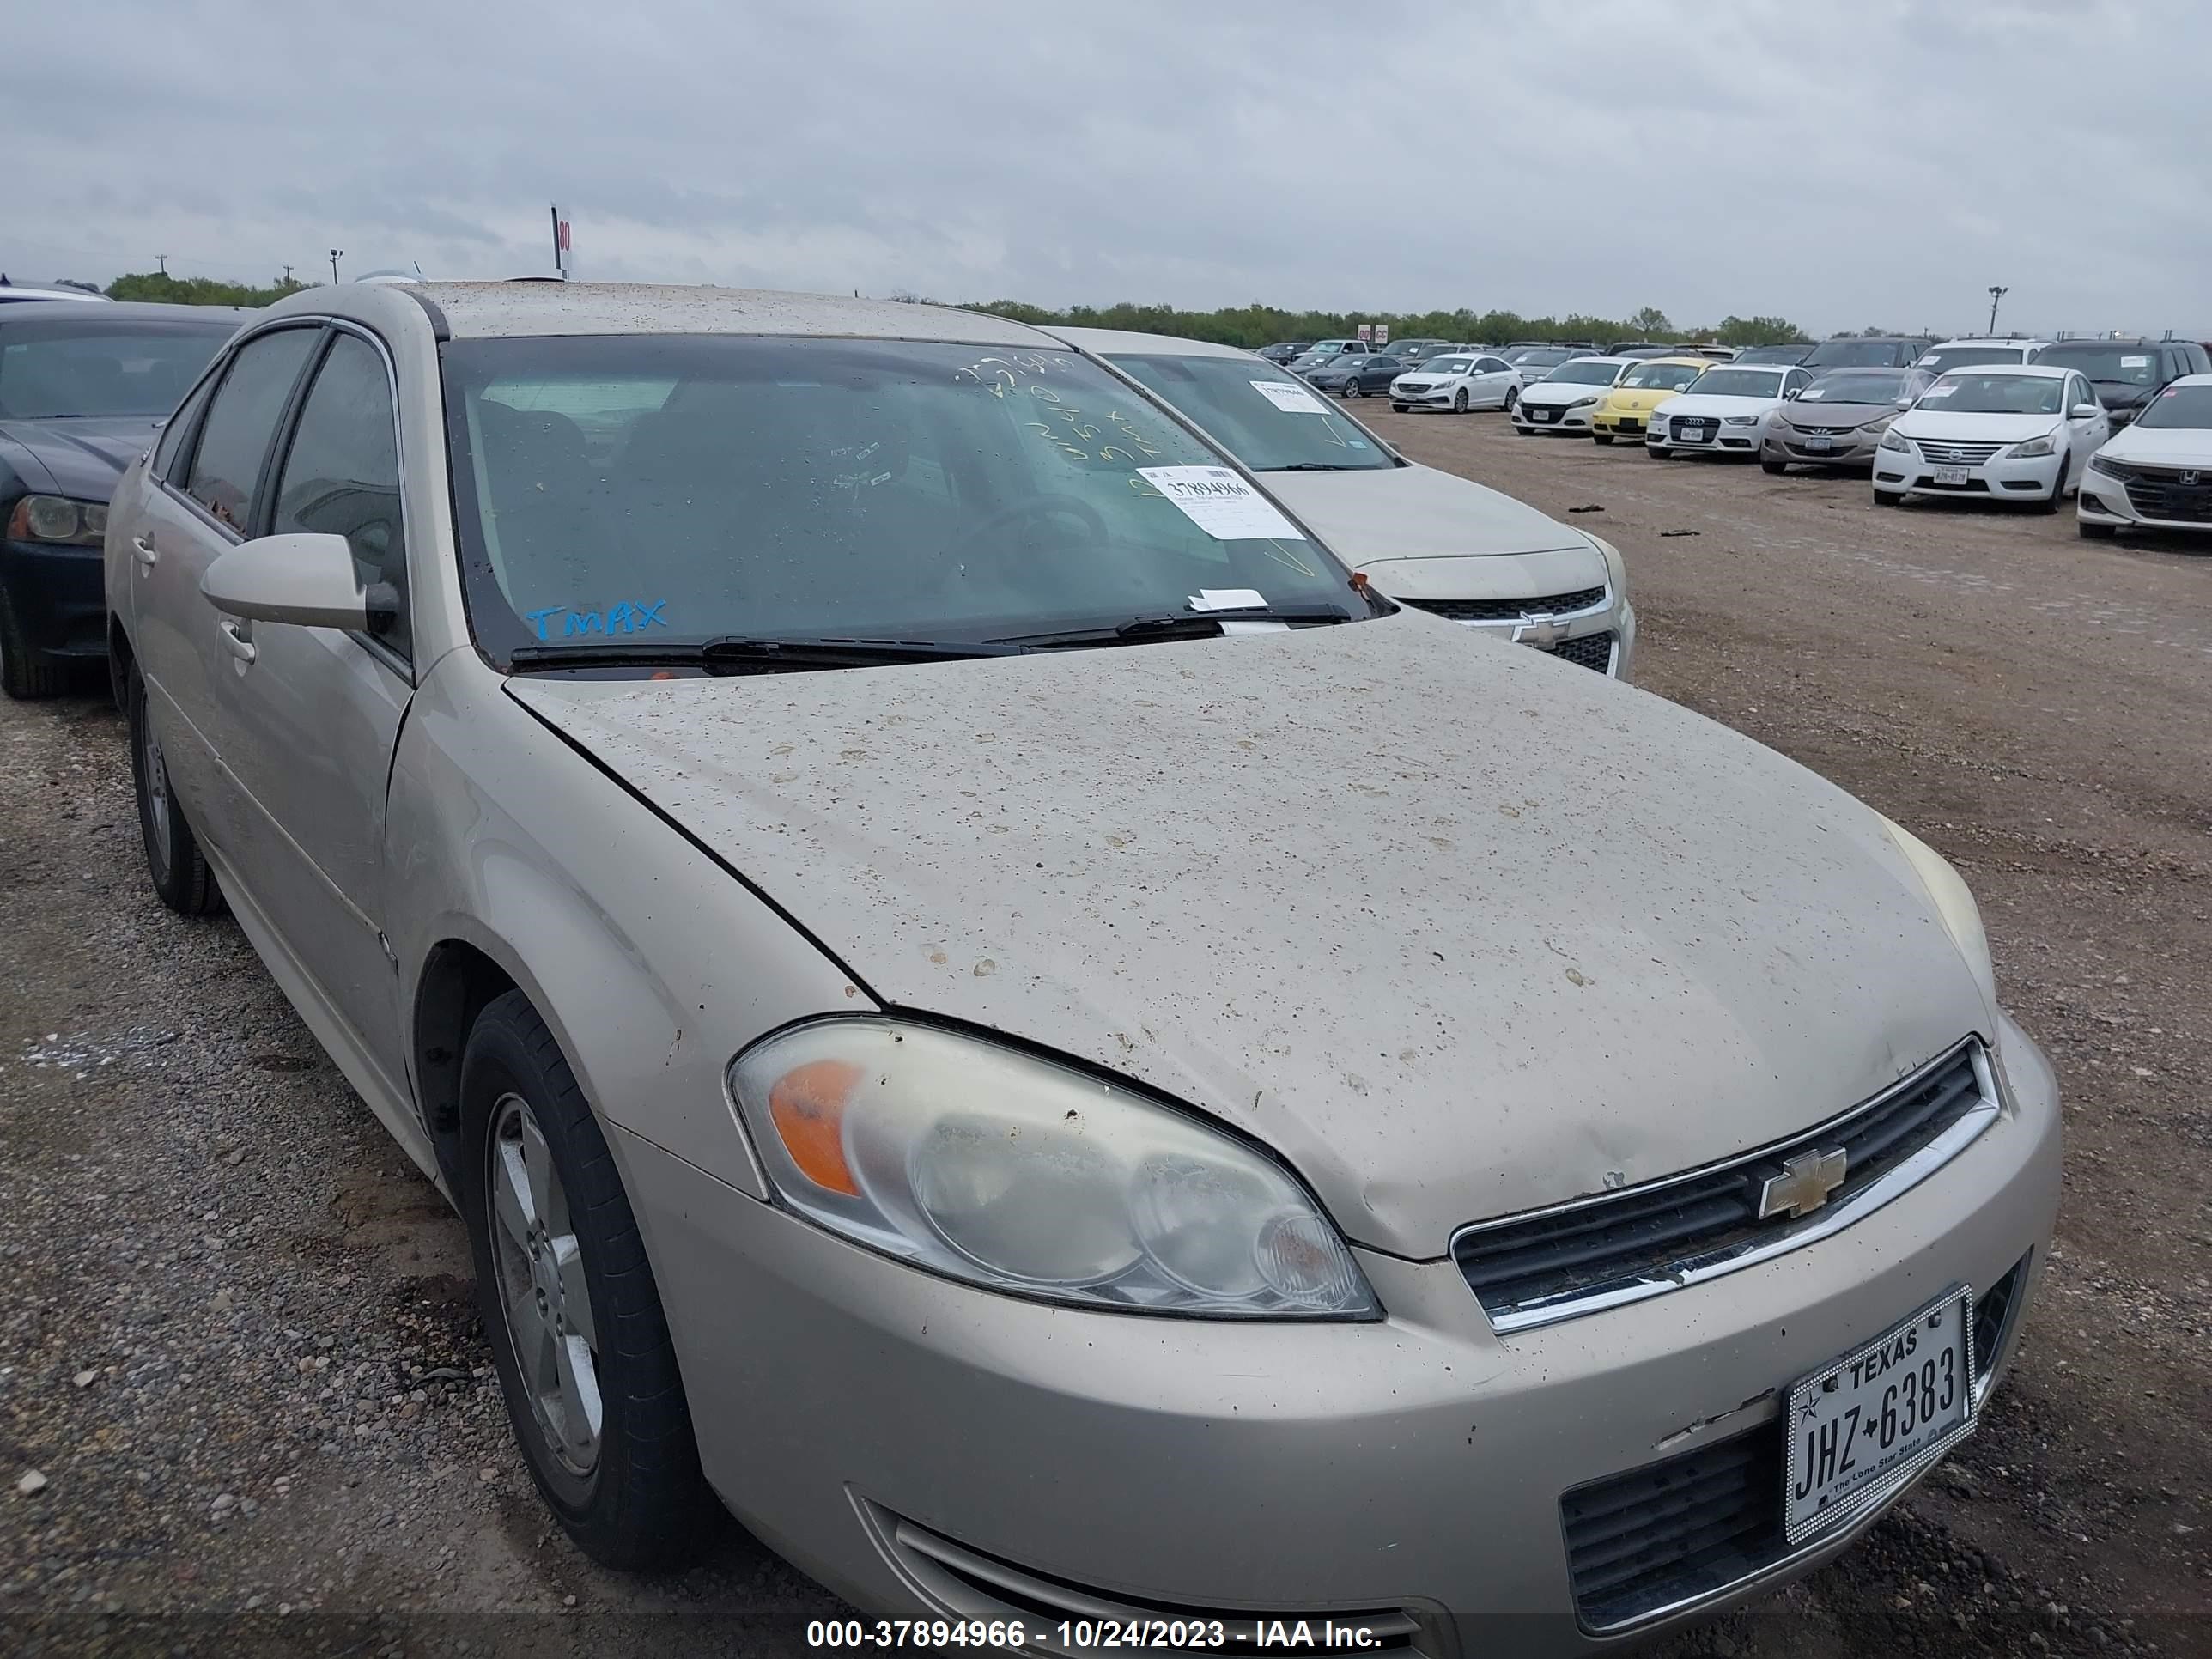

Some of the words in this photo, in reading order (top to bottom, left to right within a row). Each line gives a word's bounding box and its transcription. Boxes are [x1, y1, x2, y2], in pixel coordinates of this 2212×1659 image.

[559, 220, 570, 252] 80
[1167, 482, 1250, 496] 37894966
[1850, 1328, 1917, 1389] TEXAS
[1834, 1479, 1850, 1492] The
[1853, 1465, 1875, 1481] Lone
[1878, 1453, 1897, 1468] Star
[1899, 1437, 1921, 1455] State
